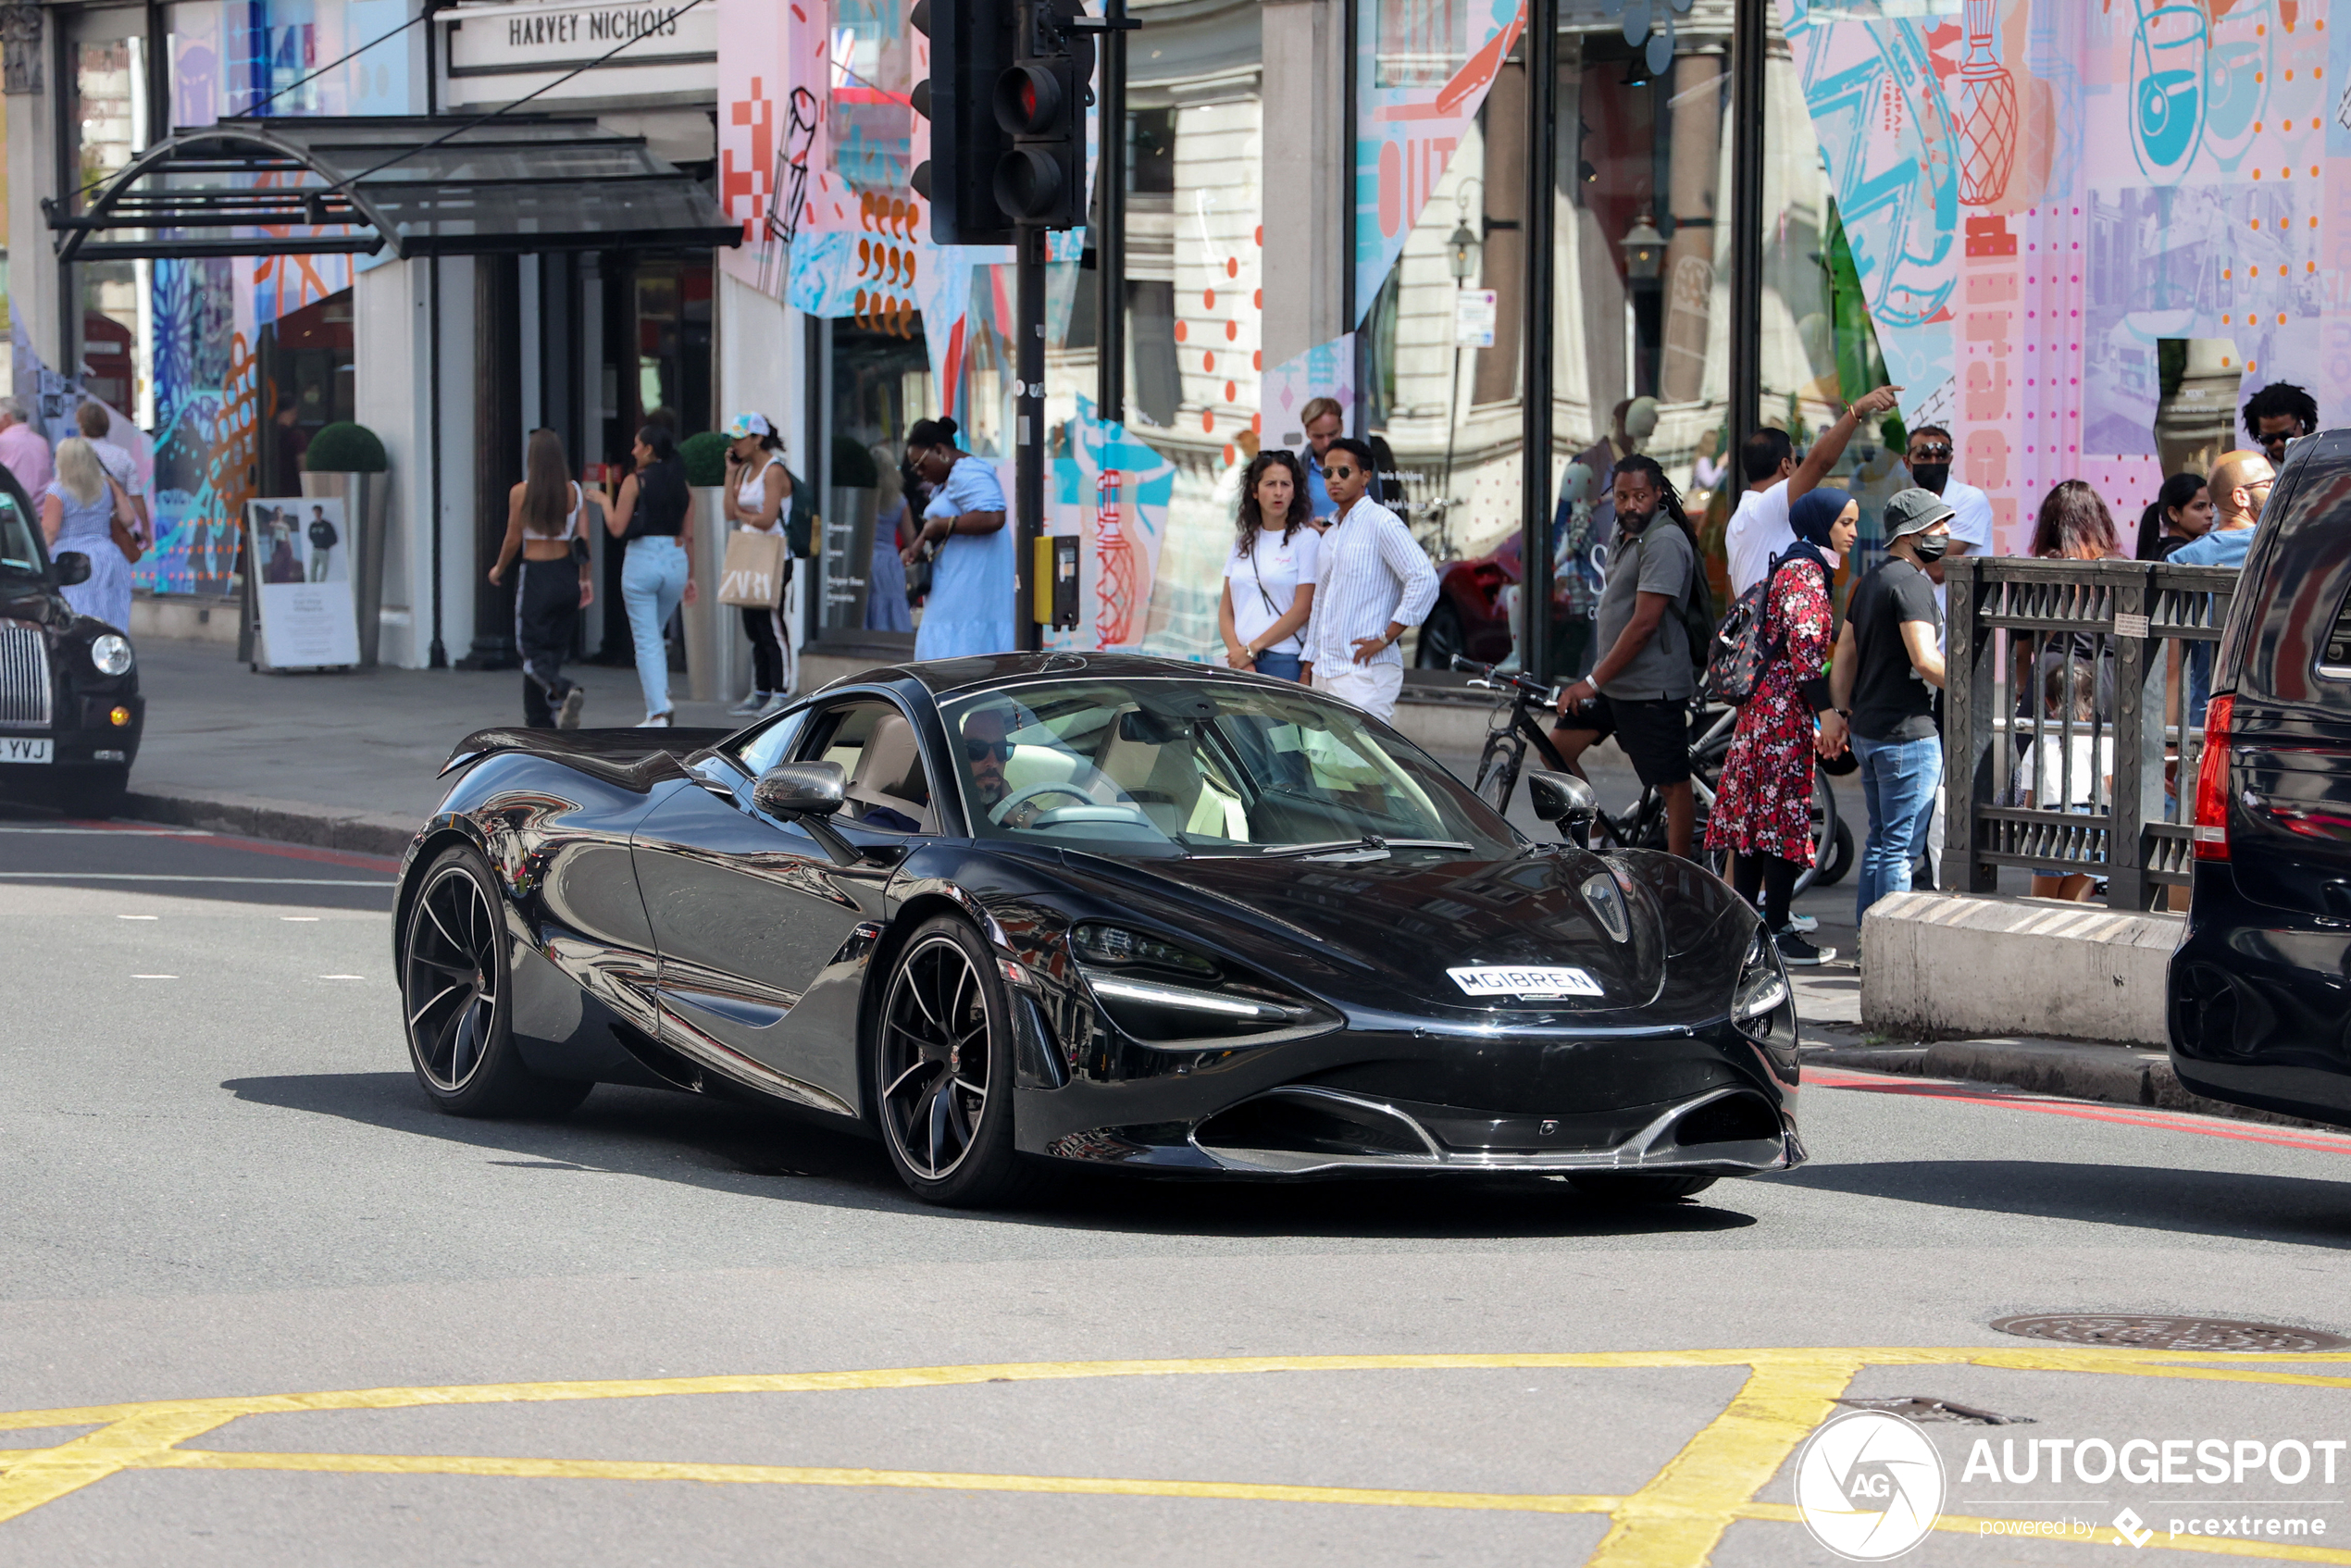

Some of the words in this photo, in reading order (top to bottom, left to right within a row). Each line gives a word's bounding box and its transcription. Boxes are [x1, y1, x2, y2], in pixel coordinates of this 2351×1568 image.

[509, 14, 578, 46] HARVEY
[590, 7, 677, 41] NICHOLS
[1378, 136, 1457, 239] OUT
[717, 569, 772, 601] ZARA
[9, 740, 44, 759] YVJ
